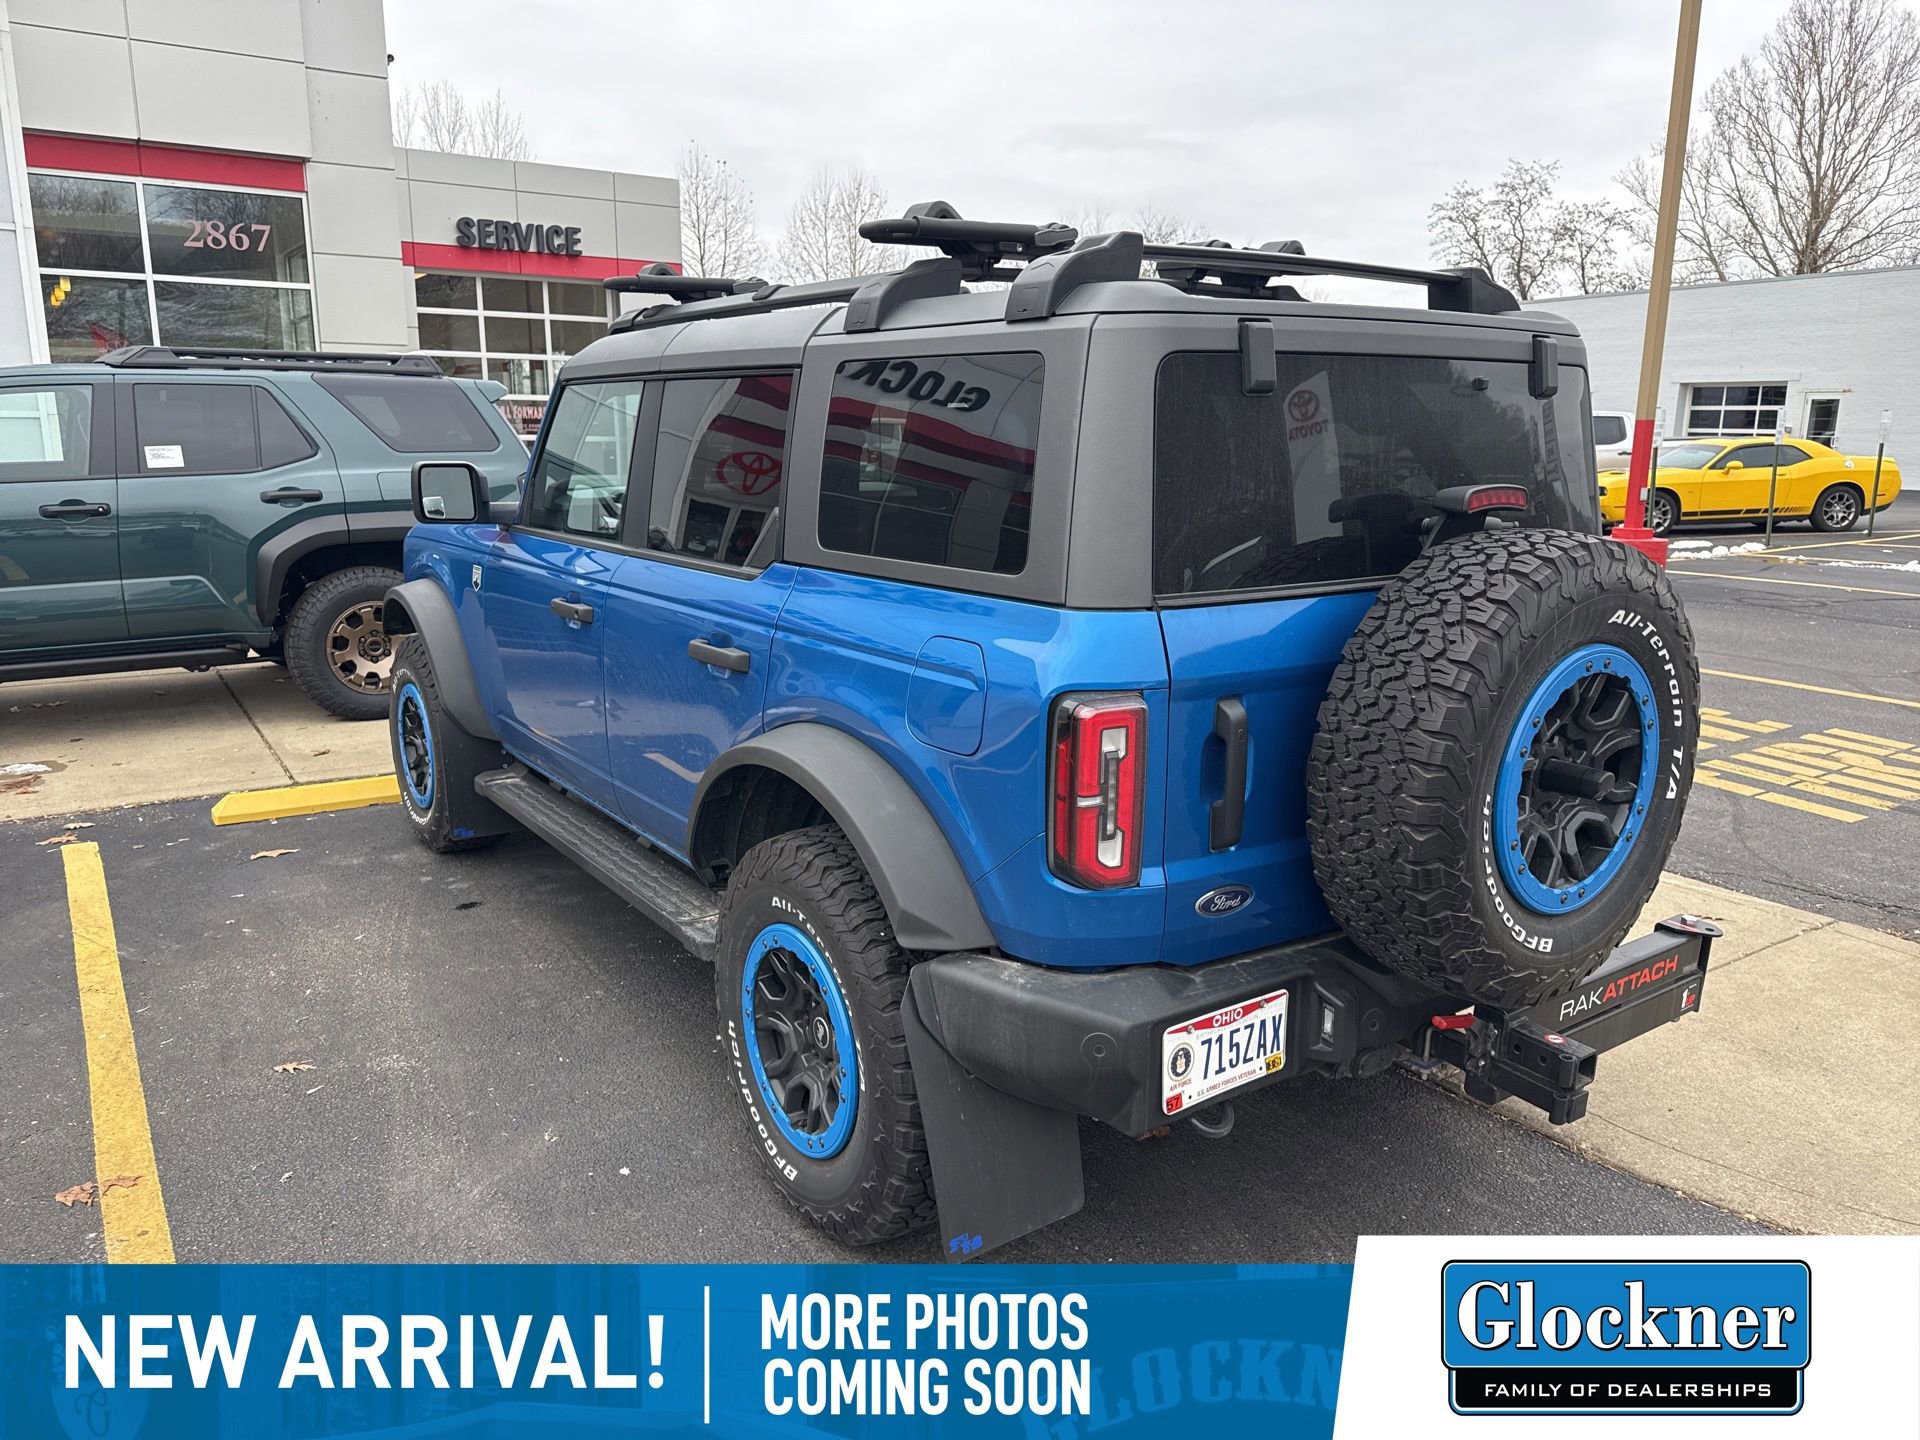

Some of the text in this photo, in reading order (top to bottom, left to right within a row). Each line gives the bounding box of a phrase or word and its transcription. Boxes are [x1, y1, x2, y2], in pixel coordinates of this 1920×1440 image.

[183, 220, 271, 252] 2867
[456, 217, 582, 256] SERVICE
[1607, 609, 1684, 800] All-Terrain T/A
[1482, 794, 1554, 953] BFGoodrich
[1210, 894, 1242, 911] Ford
[1212, 1007, 1244, 1028] OHIO
[1201, 1013, 1283, 1081] 715ZAX
[1169, 1077, 1192, 1092] AIR FORCE
[1206, 1081, 1221, 1093] ARMED
[1221, 1074, 1238, 1088] FORCES
[1238, 1068, 1257, 1082] VETERAN
